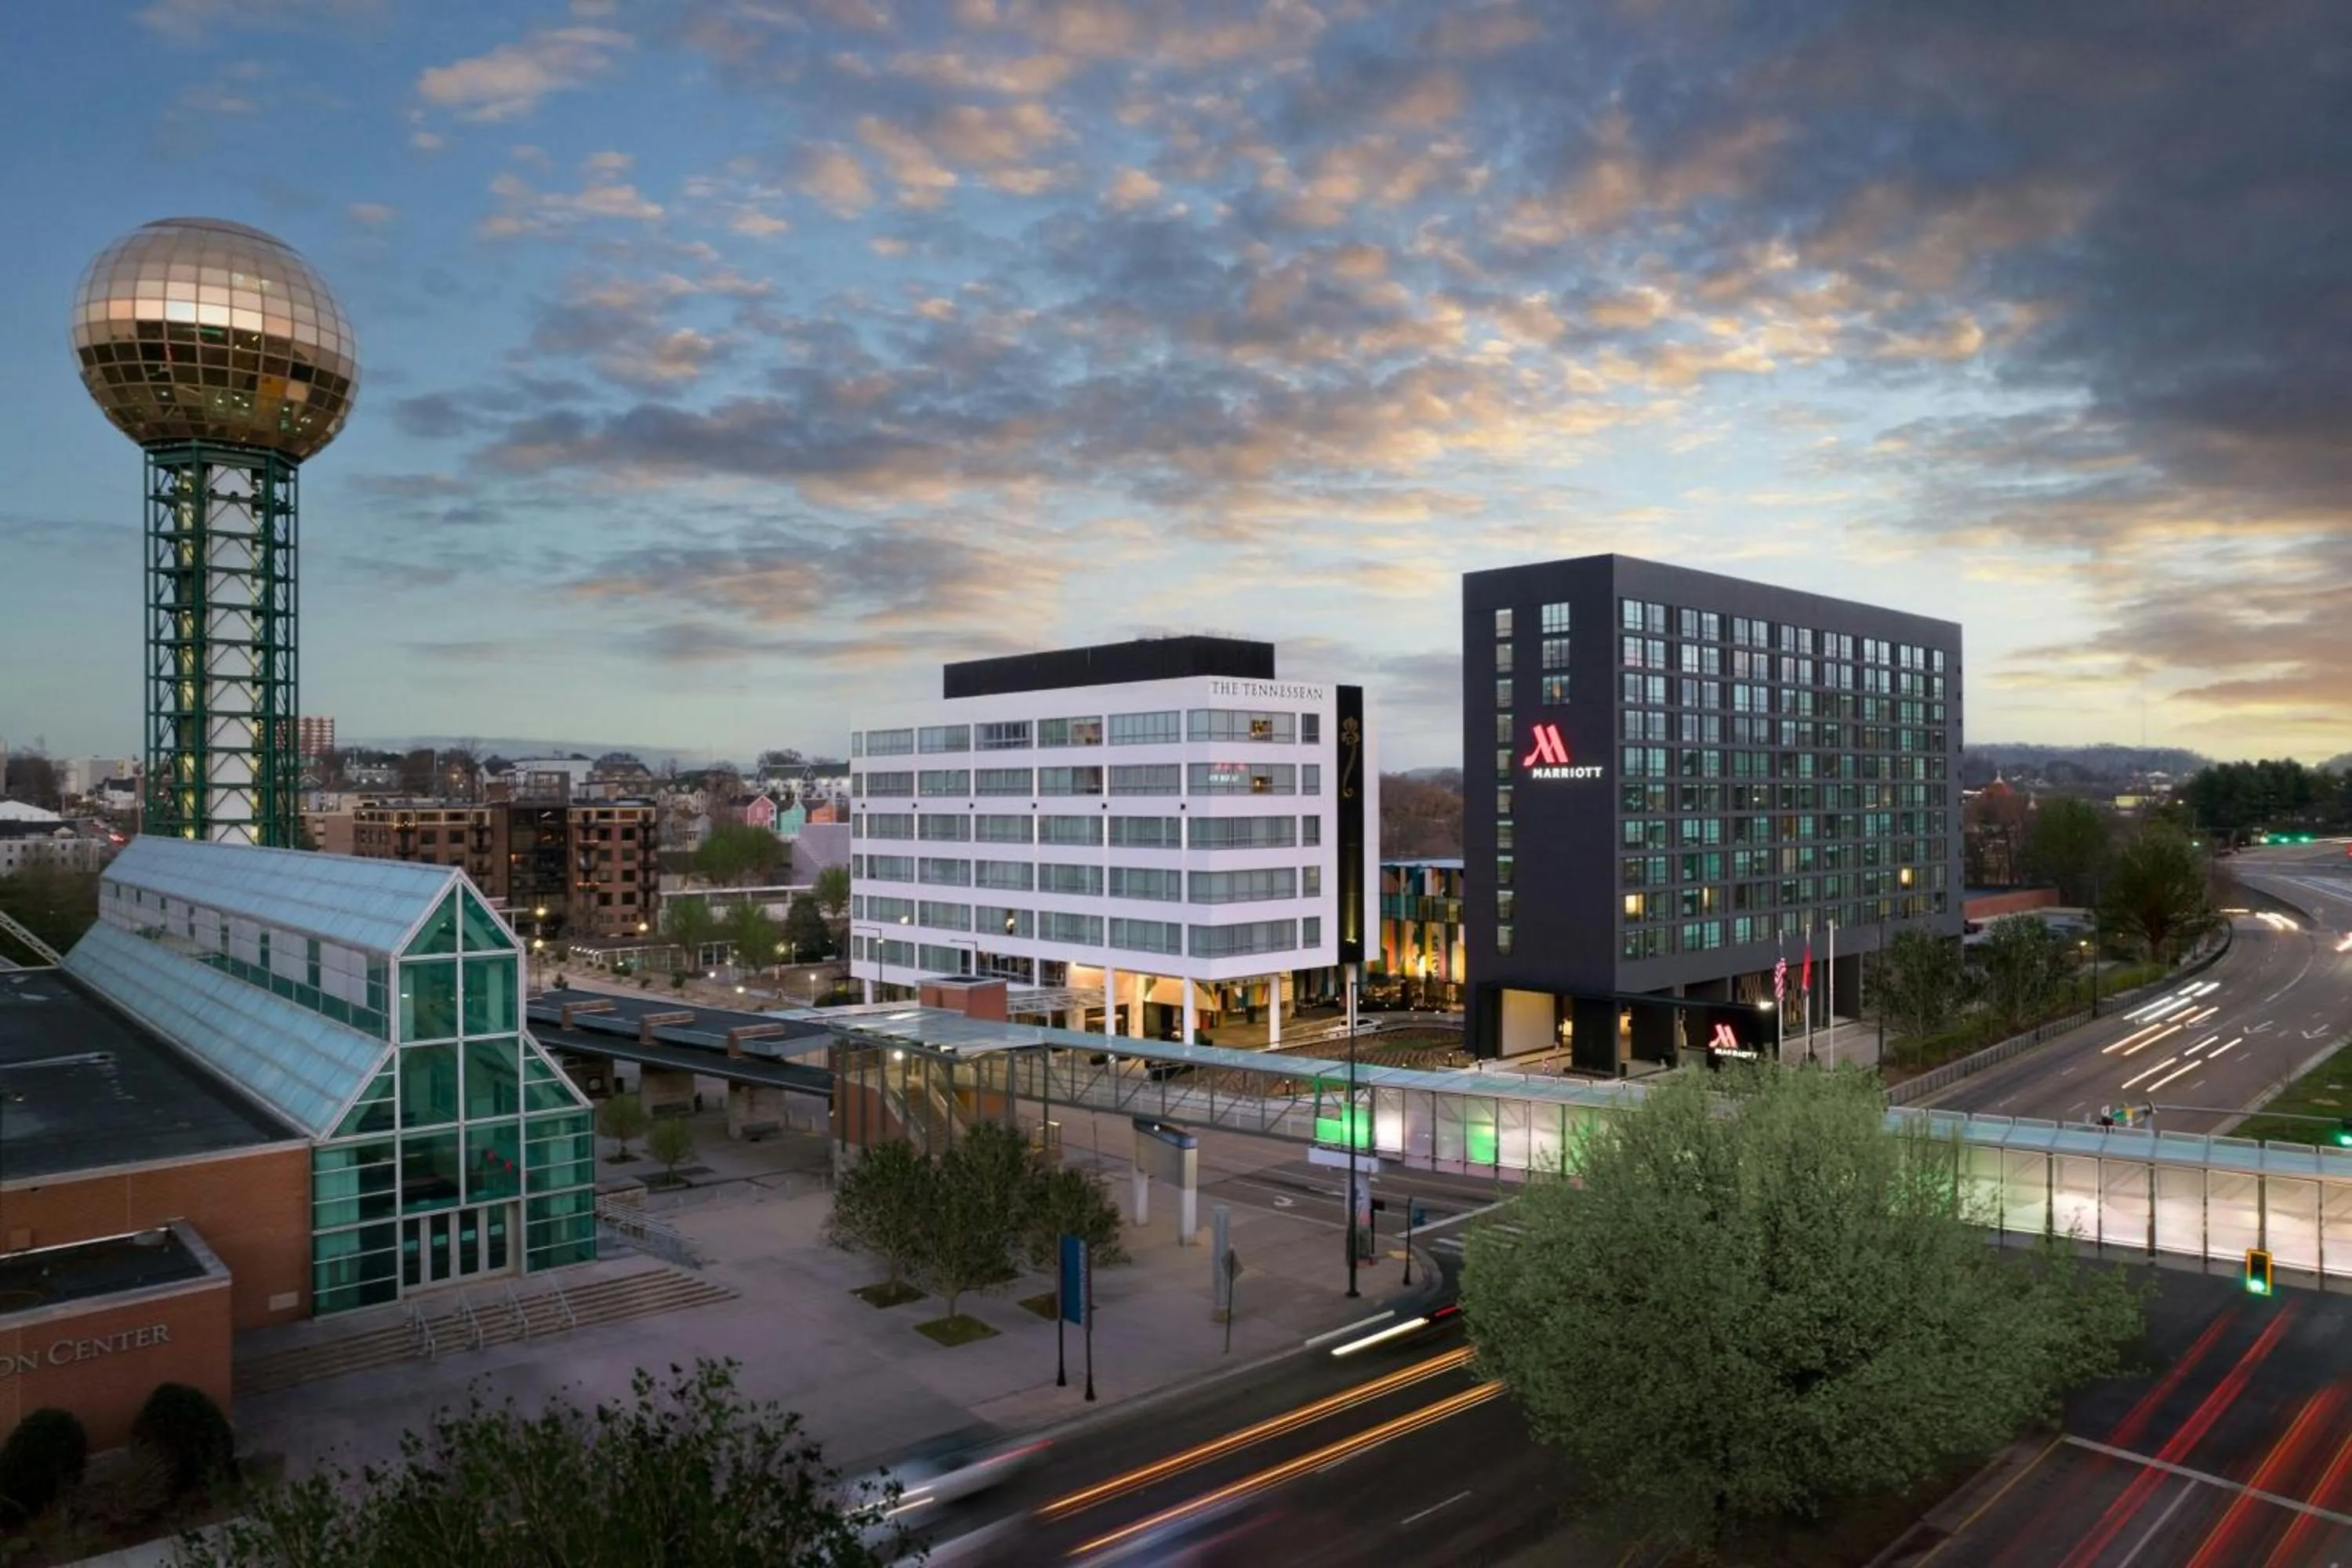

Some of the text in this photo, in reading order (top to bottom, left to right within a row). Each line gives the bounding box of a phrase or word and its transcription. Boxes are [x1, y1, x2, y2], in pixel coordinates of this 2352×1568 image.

[1212, 681, 1323, 700] THE TENNESSEAN
[1532, 766, 1603, 779] MARRIOTT
[47, 1323, 172, 1366] CENTER
